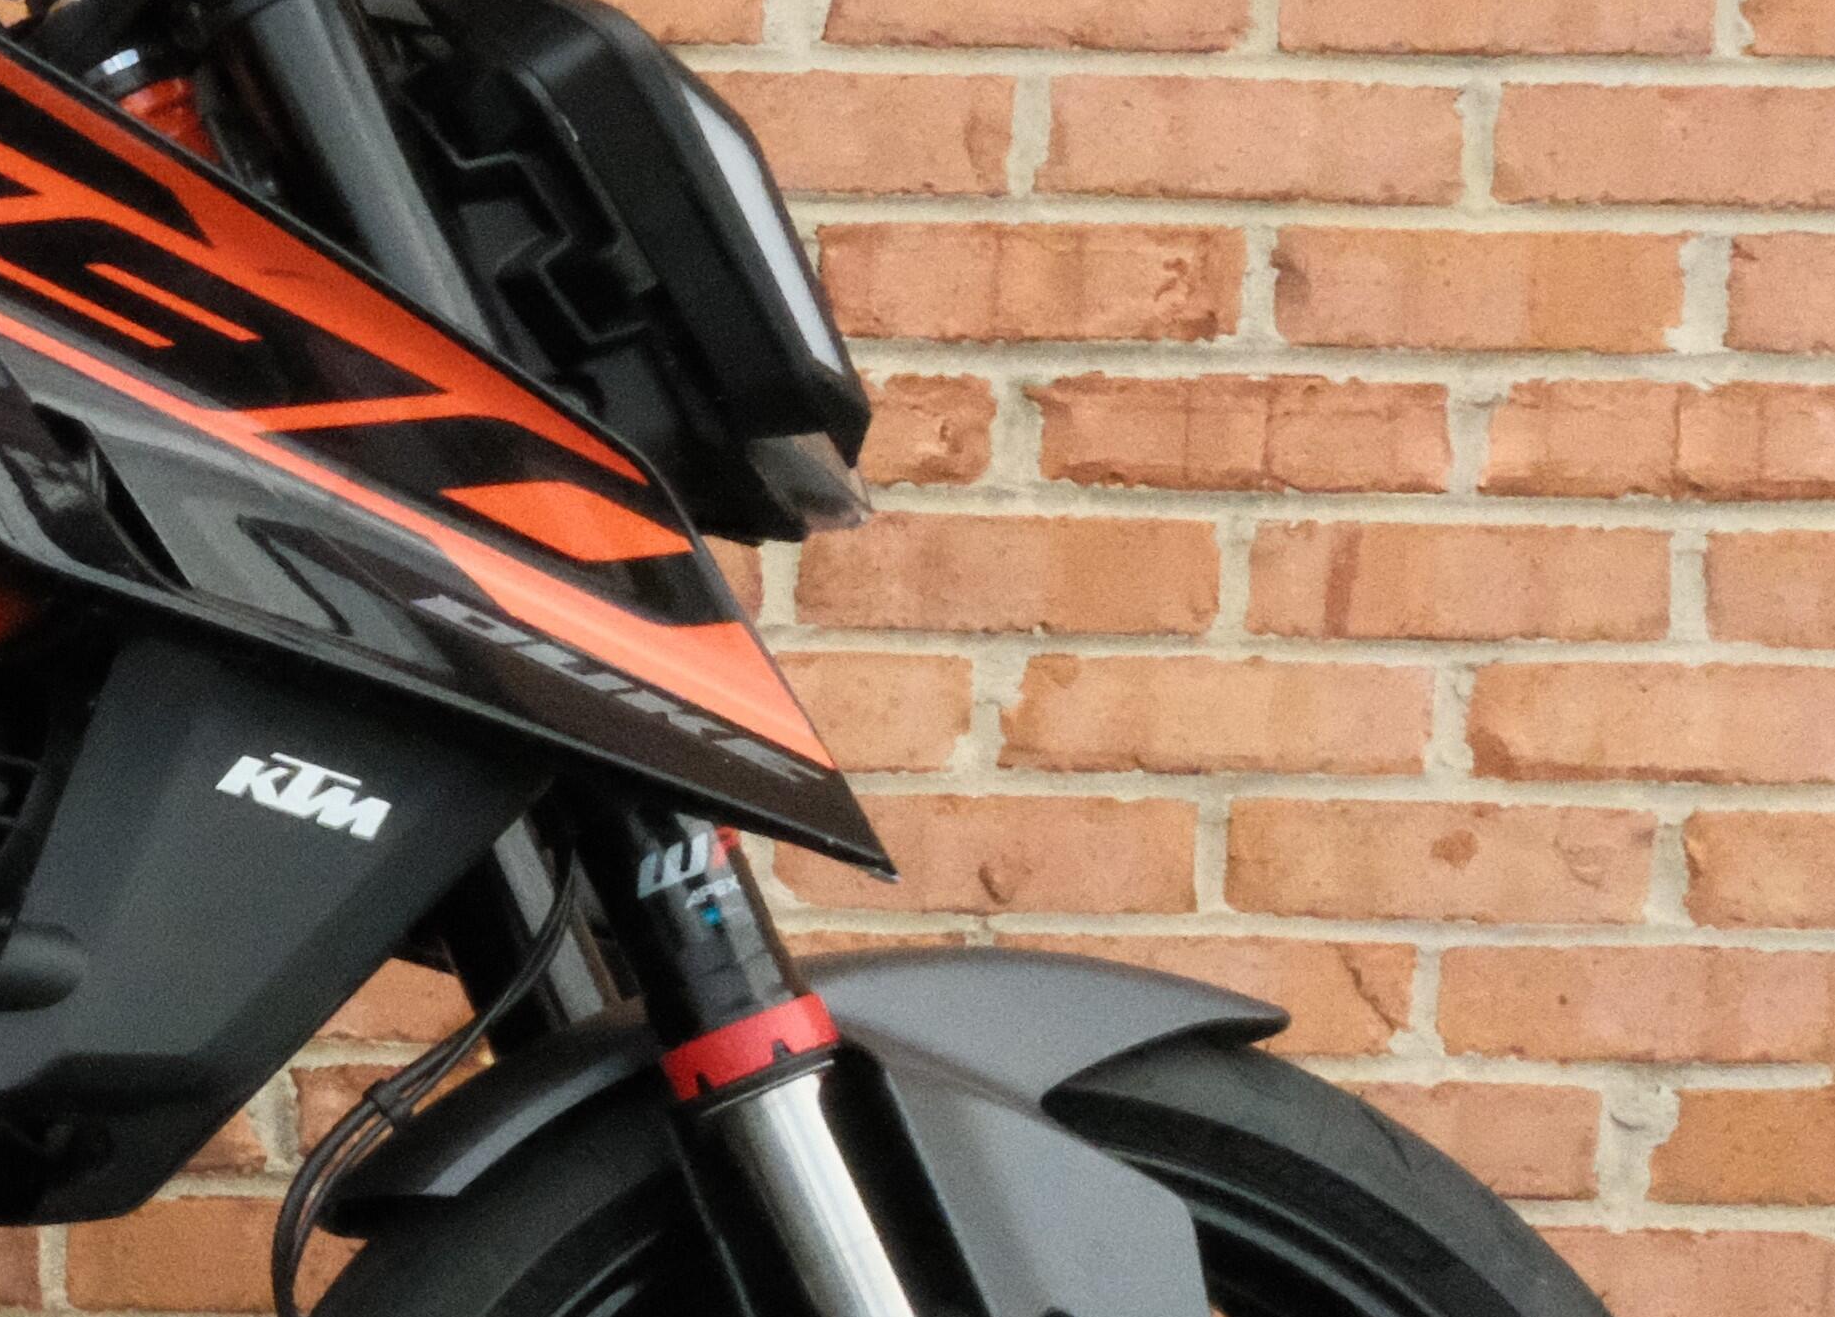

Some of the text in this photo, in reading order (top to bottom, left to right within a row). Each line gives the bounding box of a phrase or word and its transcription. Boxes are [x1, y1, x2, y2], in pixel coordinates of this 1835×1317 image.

[411, 593, 827, 783] DUKE
[215, 752, 392, 841] KTM
[637, 823, 741, 900] WP
